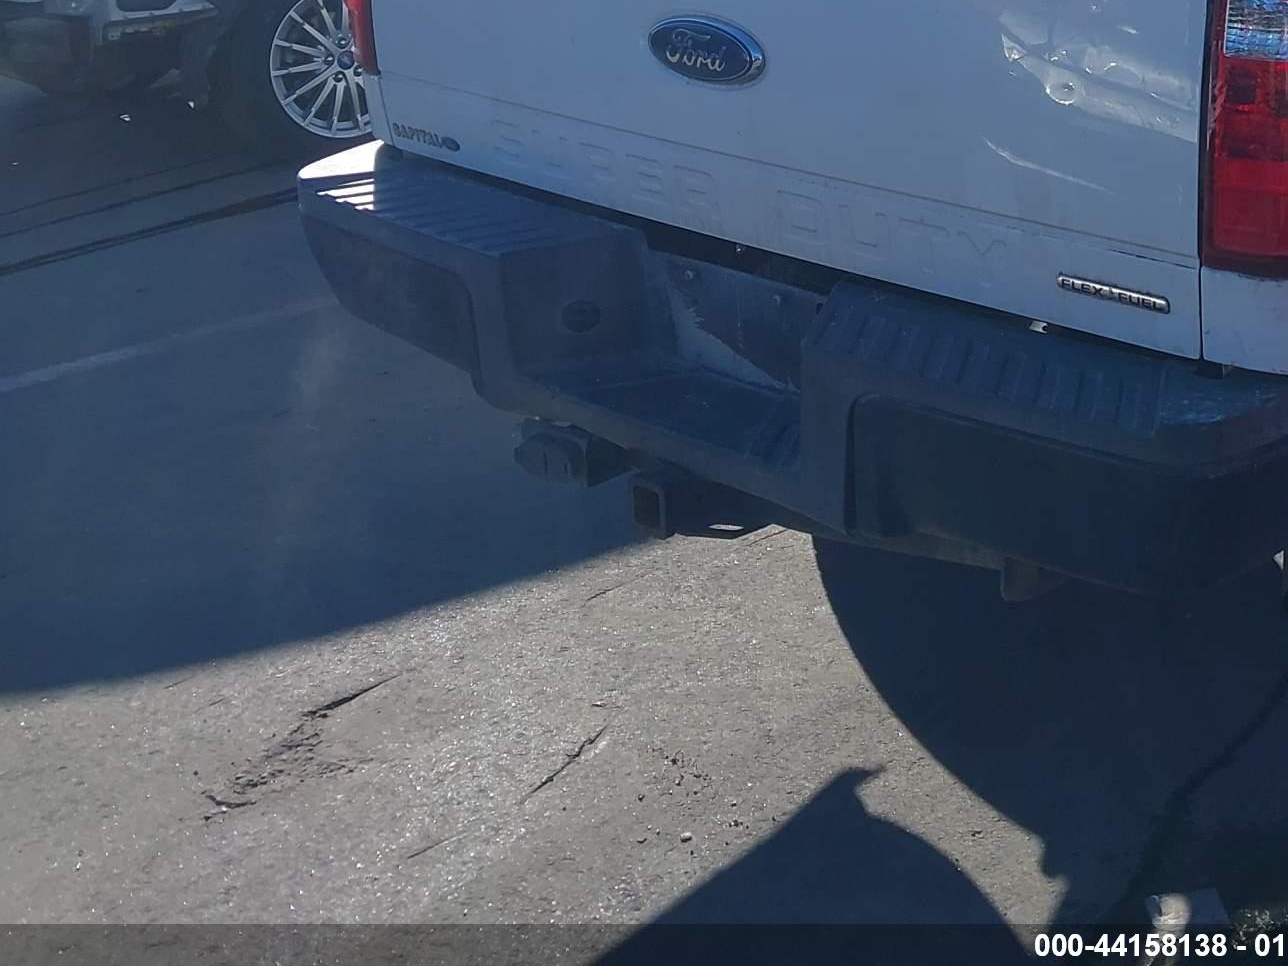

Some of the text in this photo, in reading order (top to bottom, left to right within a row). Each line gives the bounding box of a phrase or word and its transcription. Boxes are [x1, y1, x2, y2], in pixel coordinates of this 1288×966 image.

[665, 27, 727, 72] Ford
[491, 117, 1007, 288] SUPER DUTY
[1061, 278, 1163, 311] FLEX FUEL
